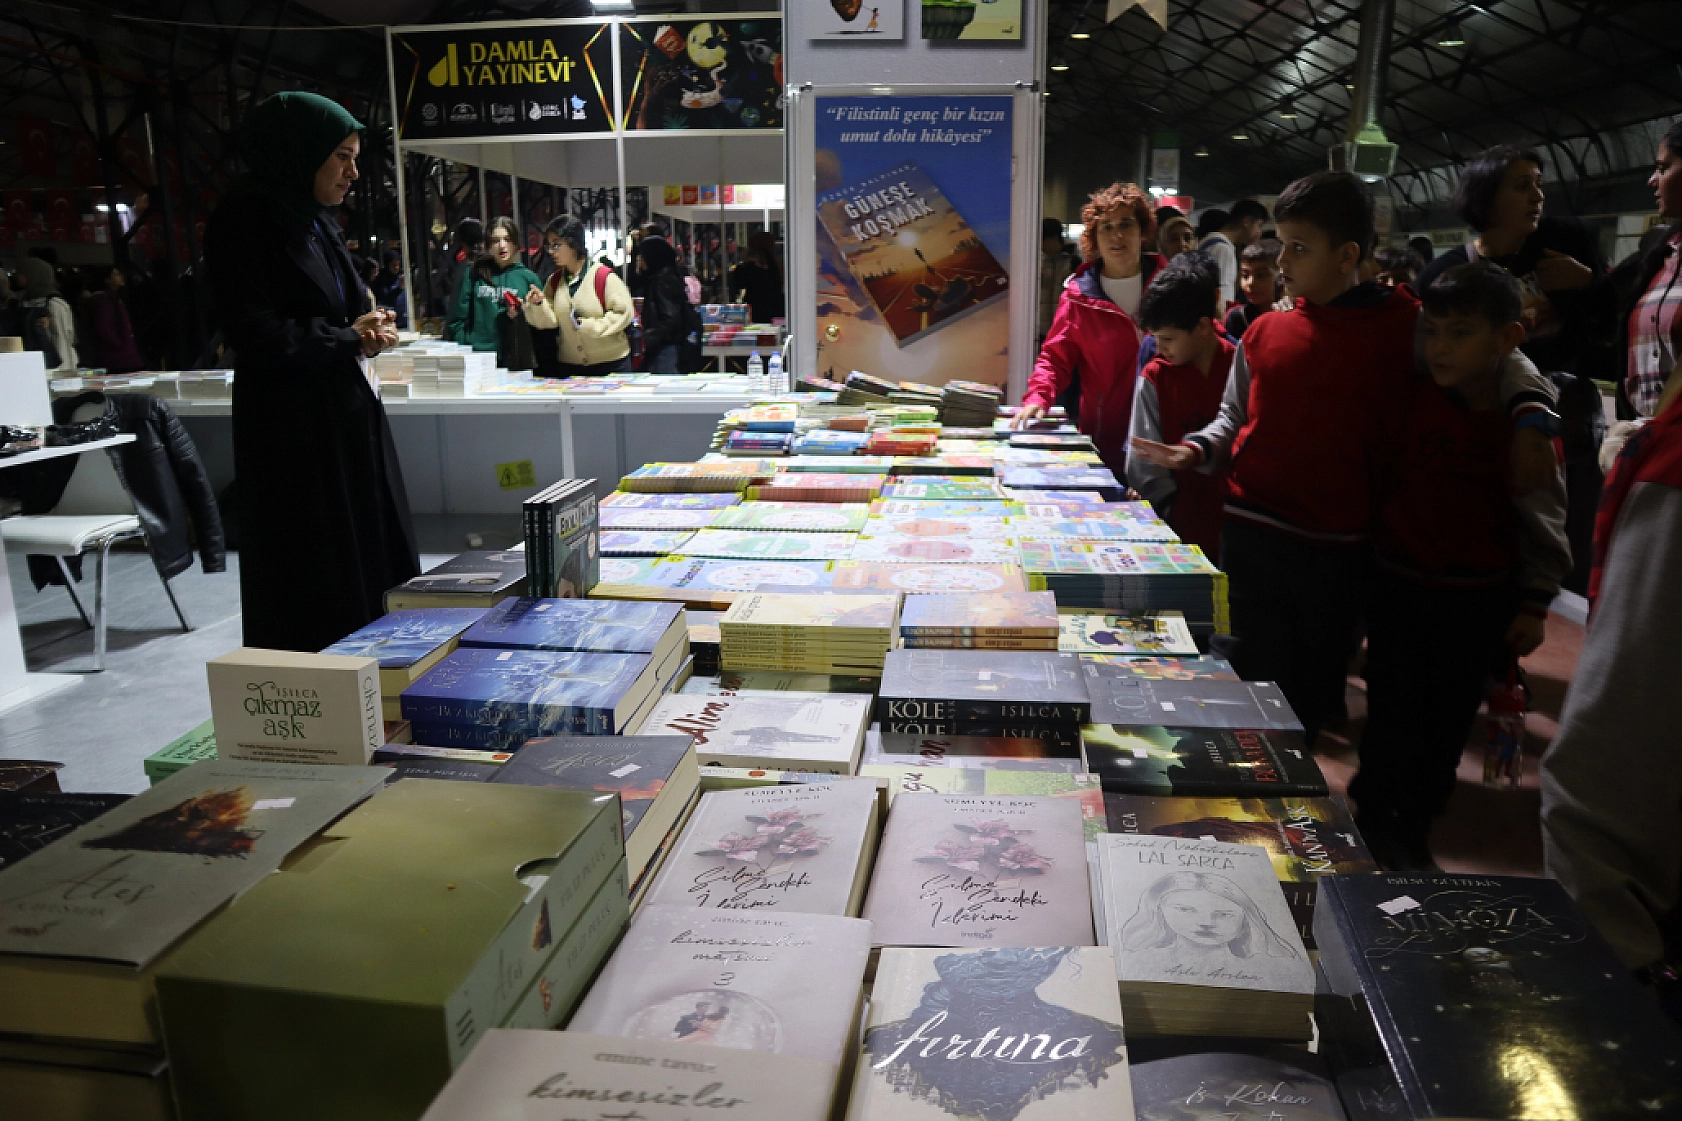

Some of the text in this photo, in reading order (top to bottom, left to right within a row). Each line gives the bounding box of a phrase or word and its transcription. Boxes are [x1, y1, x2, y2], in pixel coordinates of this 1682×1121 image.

[470, 39, 559, 63] DAMLA
[903, 110, 938, 124] genç
[943, 107, 965, 121] bir
[840, 129, 880, 143] umut
[883, 128, 916, 142] dolu
[844, 180, 917, 220] GÜNEŞE
[851, 197, 936, 242] KOŞMAK
[888, 698, 945, 720] KÖLE
[262, 715, 307, 740] aşk
[1138, 850, 1170, 865] LAL
[713, 971, 735, 986] 3
[526, 1071, 751, 1109] kimsesizler
